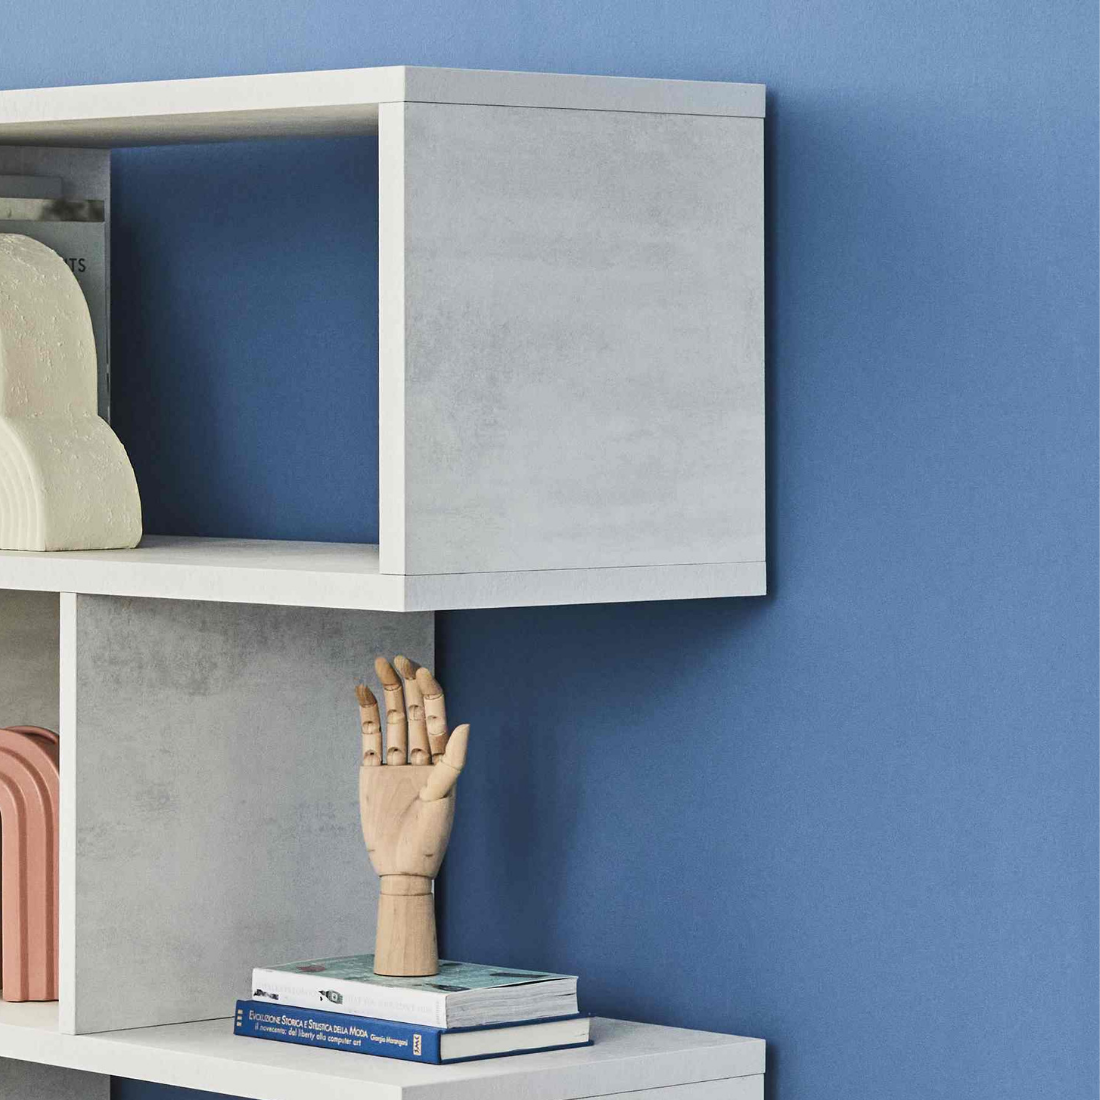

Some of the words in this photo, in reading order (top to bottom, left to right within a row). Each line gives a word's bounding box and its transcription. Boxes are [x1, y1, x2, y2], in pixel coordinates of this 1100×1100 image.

[298, 1029, 315, 1041] liberty
[327, 1036, 352, 1046] computer
[352, 1038, 362, 1046] art
